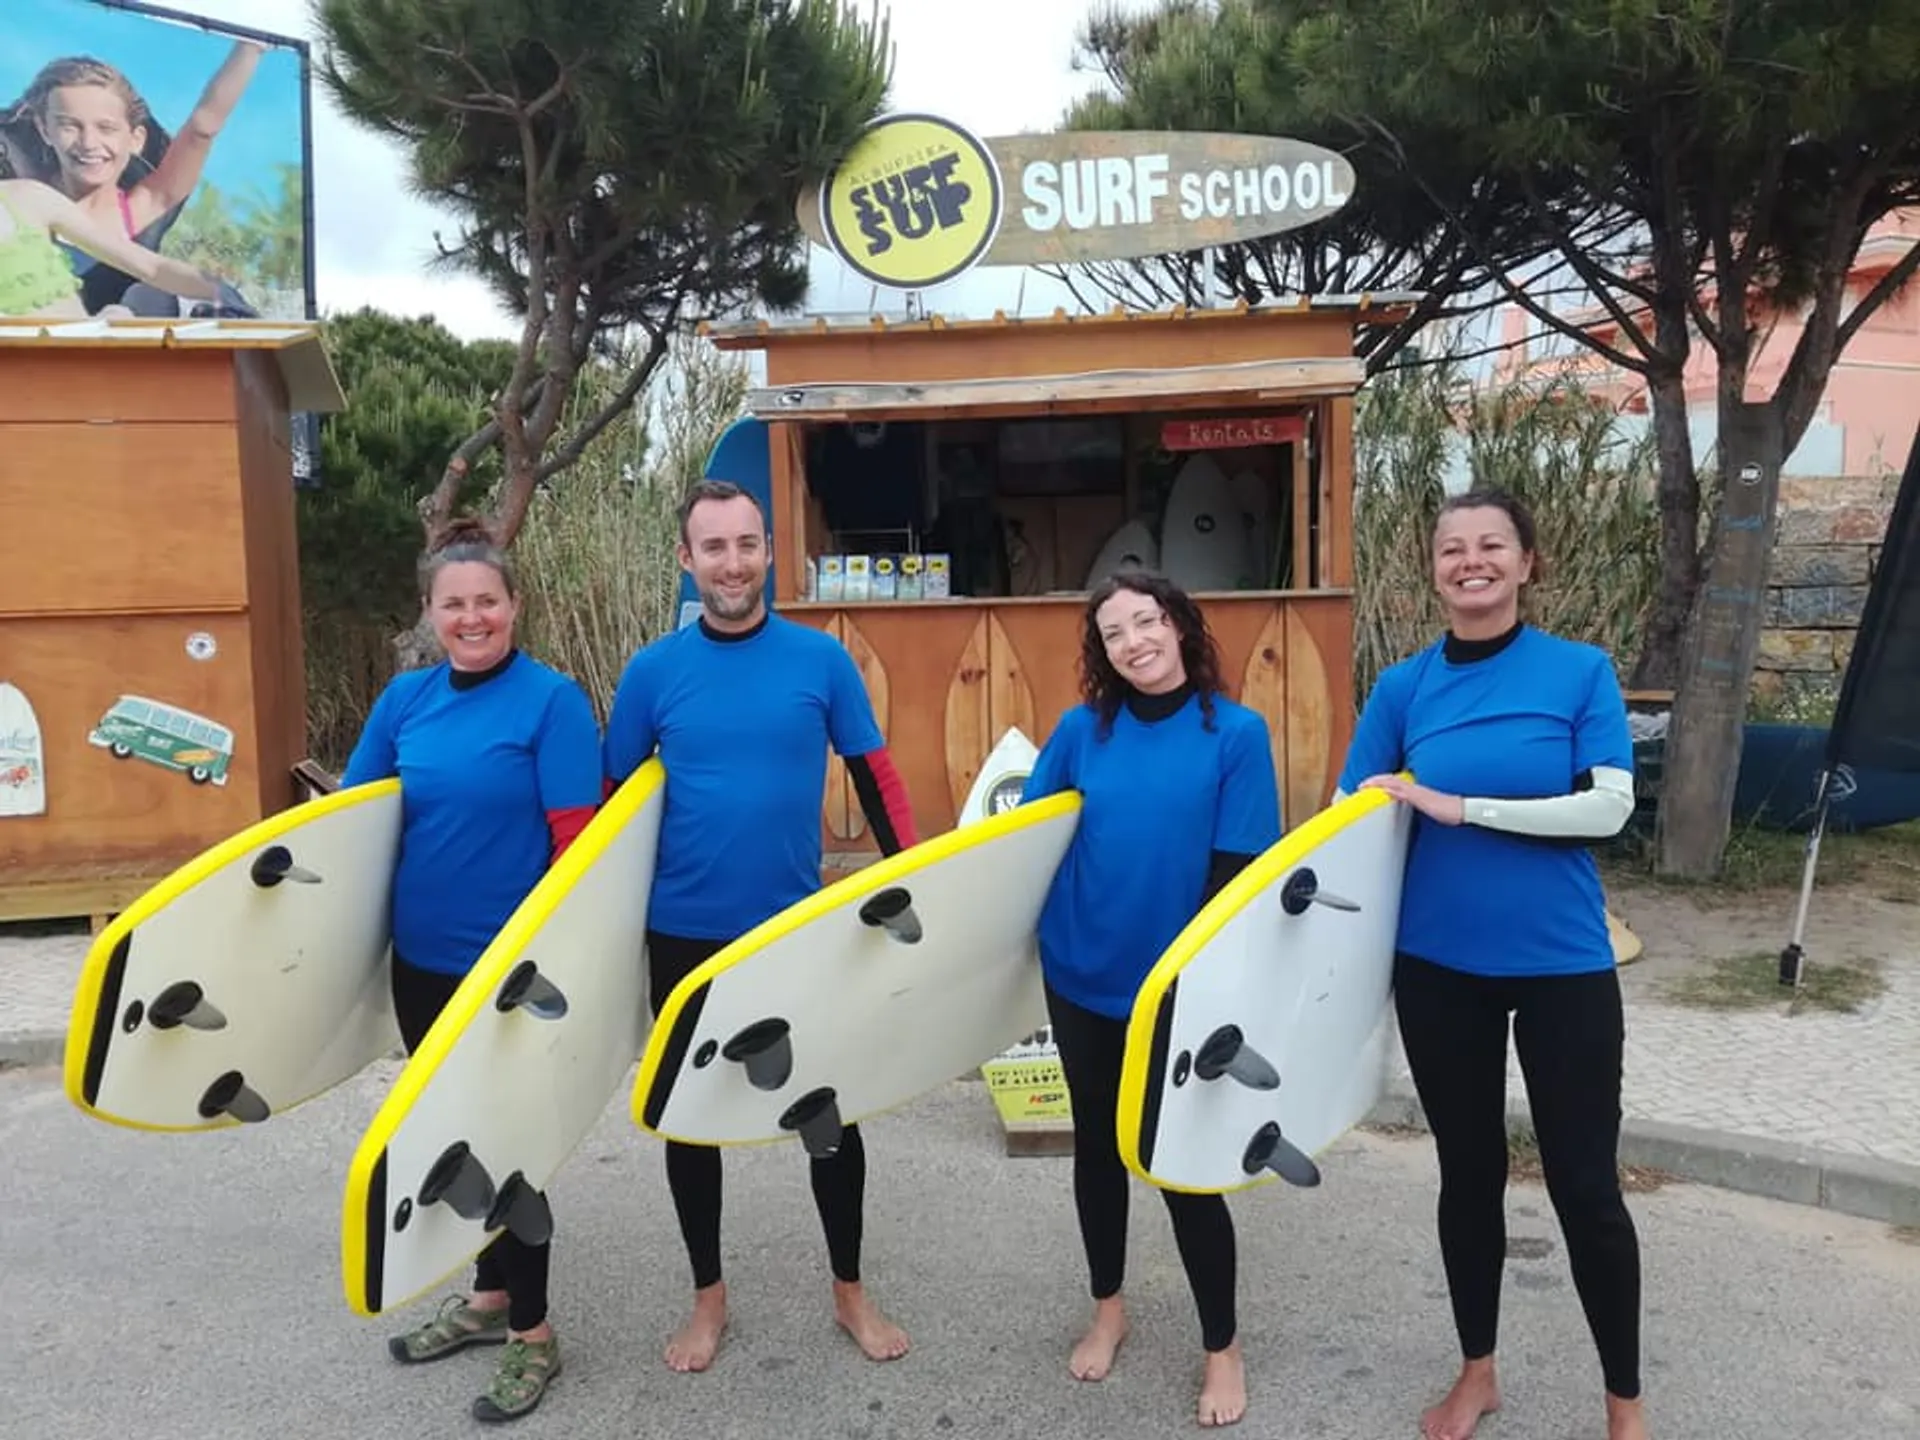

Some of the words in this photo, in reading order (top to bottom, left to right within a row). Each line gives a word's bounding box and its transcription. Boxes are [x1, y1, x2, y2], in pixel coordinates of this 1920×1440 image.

[849, 152, 961, 221] SURF
[856, 181, 972, 257] SUP
[1021, 153, 1170, 232] SURF
[1179, 160, 1348, 221] SCHOOL
[1188, 420, 1275, 444] Rentals
